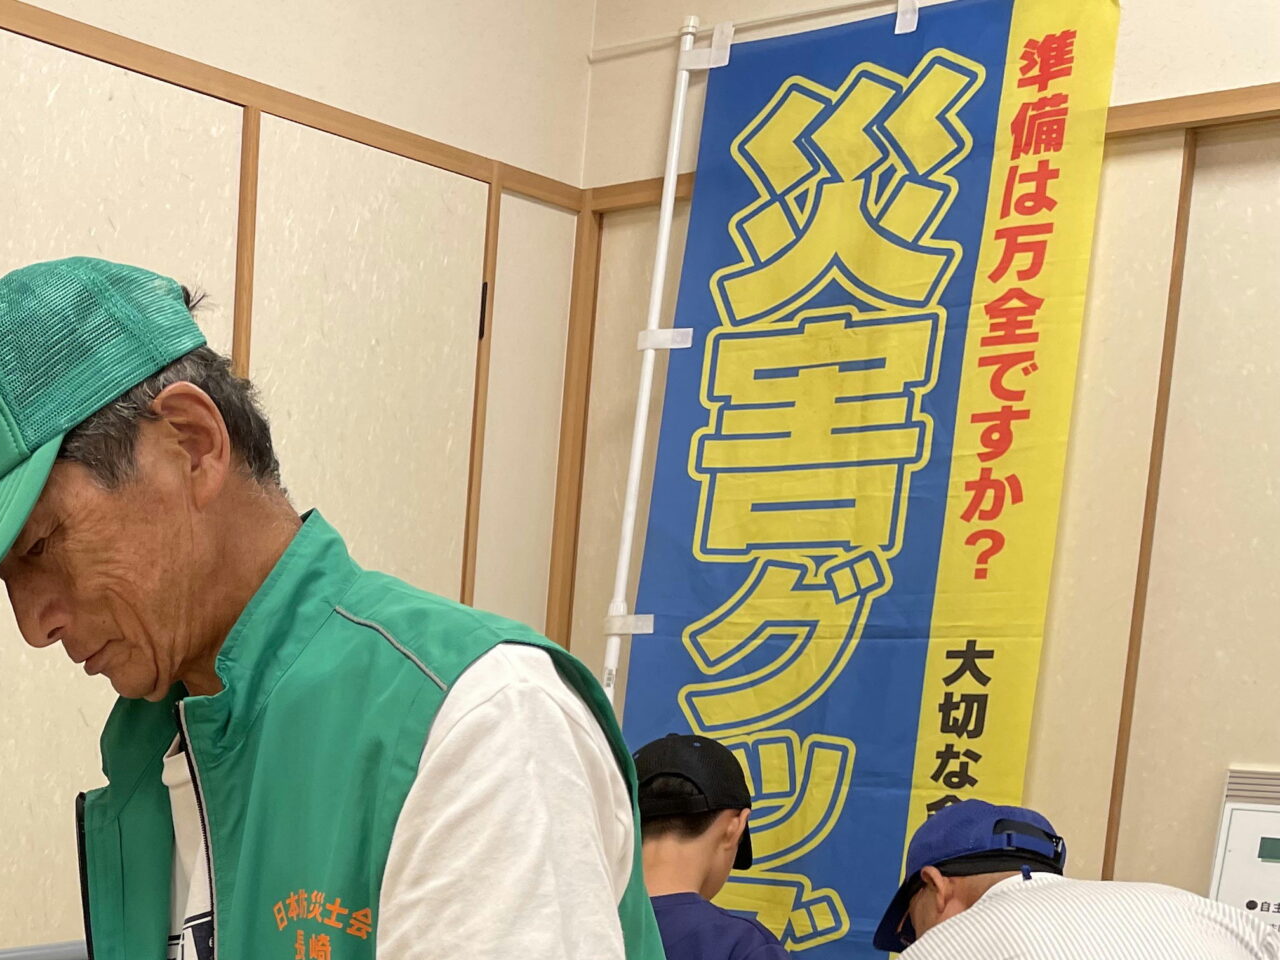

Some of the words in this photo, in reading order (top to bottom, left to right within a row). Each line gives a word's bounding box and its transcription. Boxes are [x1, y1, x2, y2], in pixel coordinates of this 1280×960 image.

[960, 29, 1077, 580] 準備は万全ですか?
